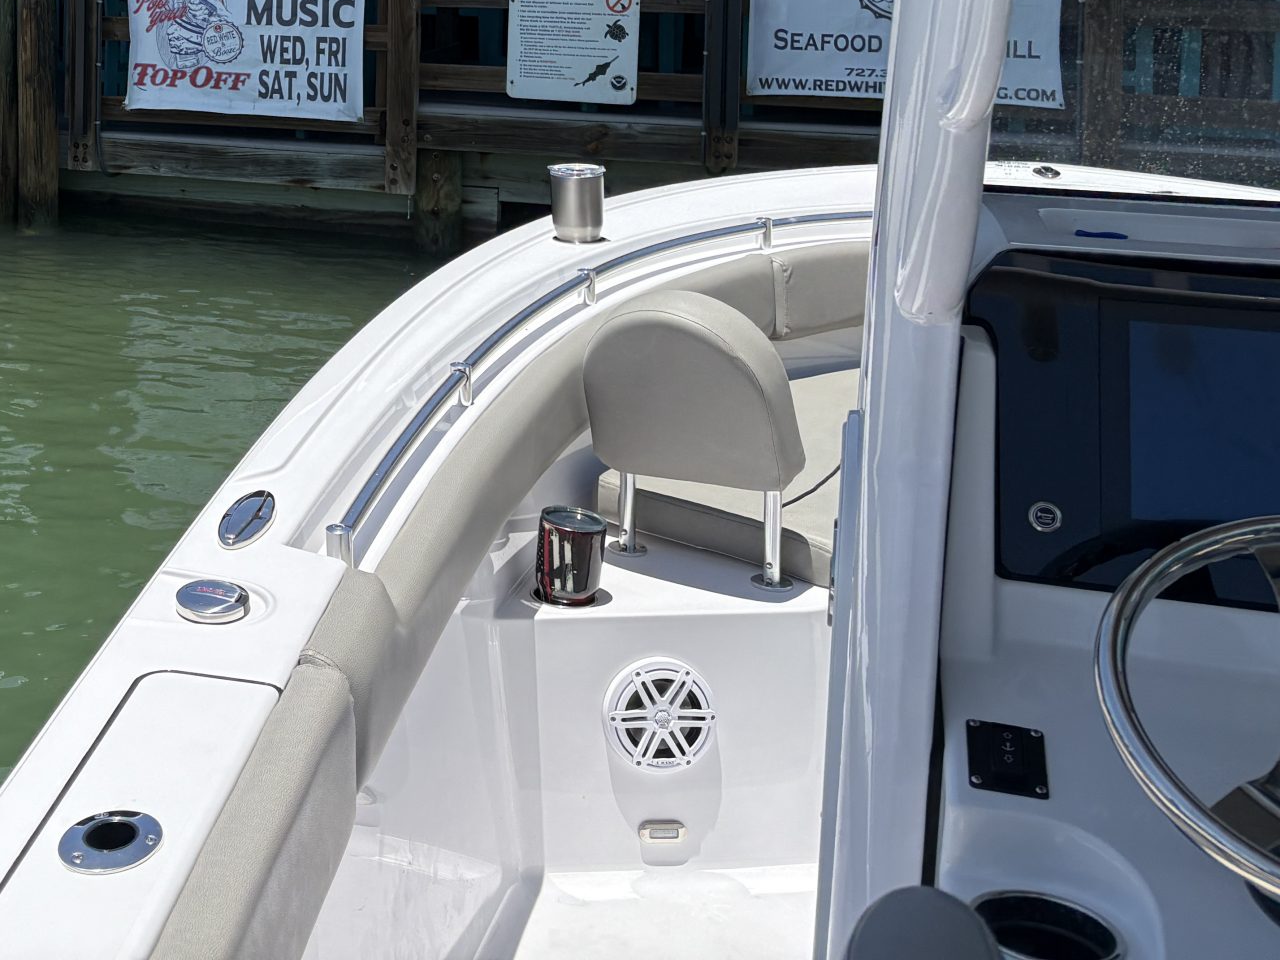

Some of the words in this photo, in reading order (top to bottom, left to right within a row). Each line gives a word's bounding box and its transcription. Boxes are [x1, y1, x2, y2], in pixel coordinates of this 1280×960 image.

[259, 34, 310, 71] WED,
[315, 36, 347, 68] FRI
[258, 69, 301, 106] SAT,
[306, 71, 348, 103] SUN
